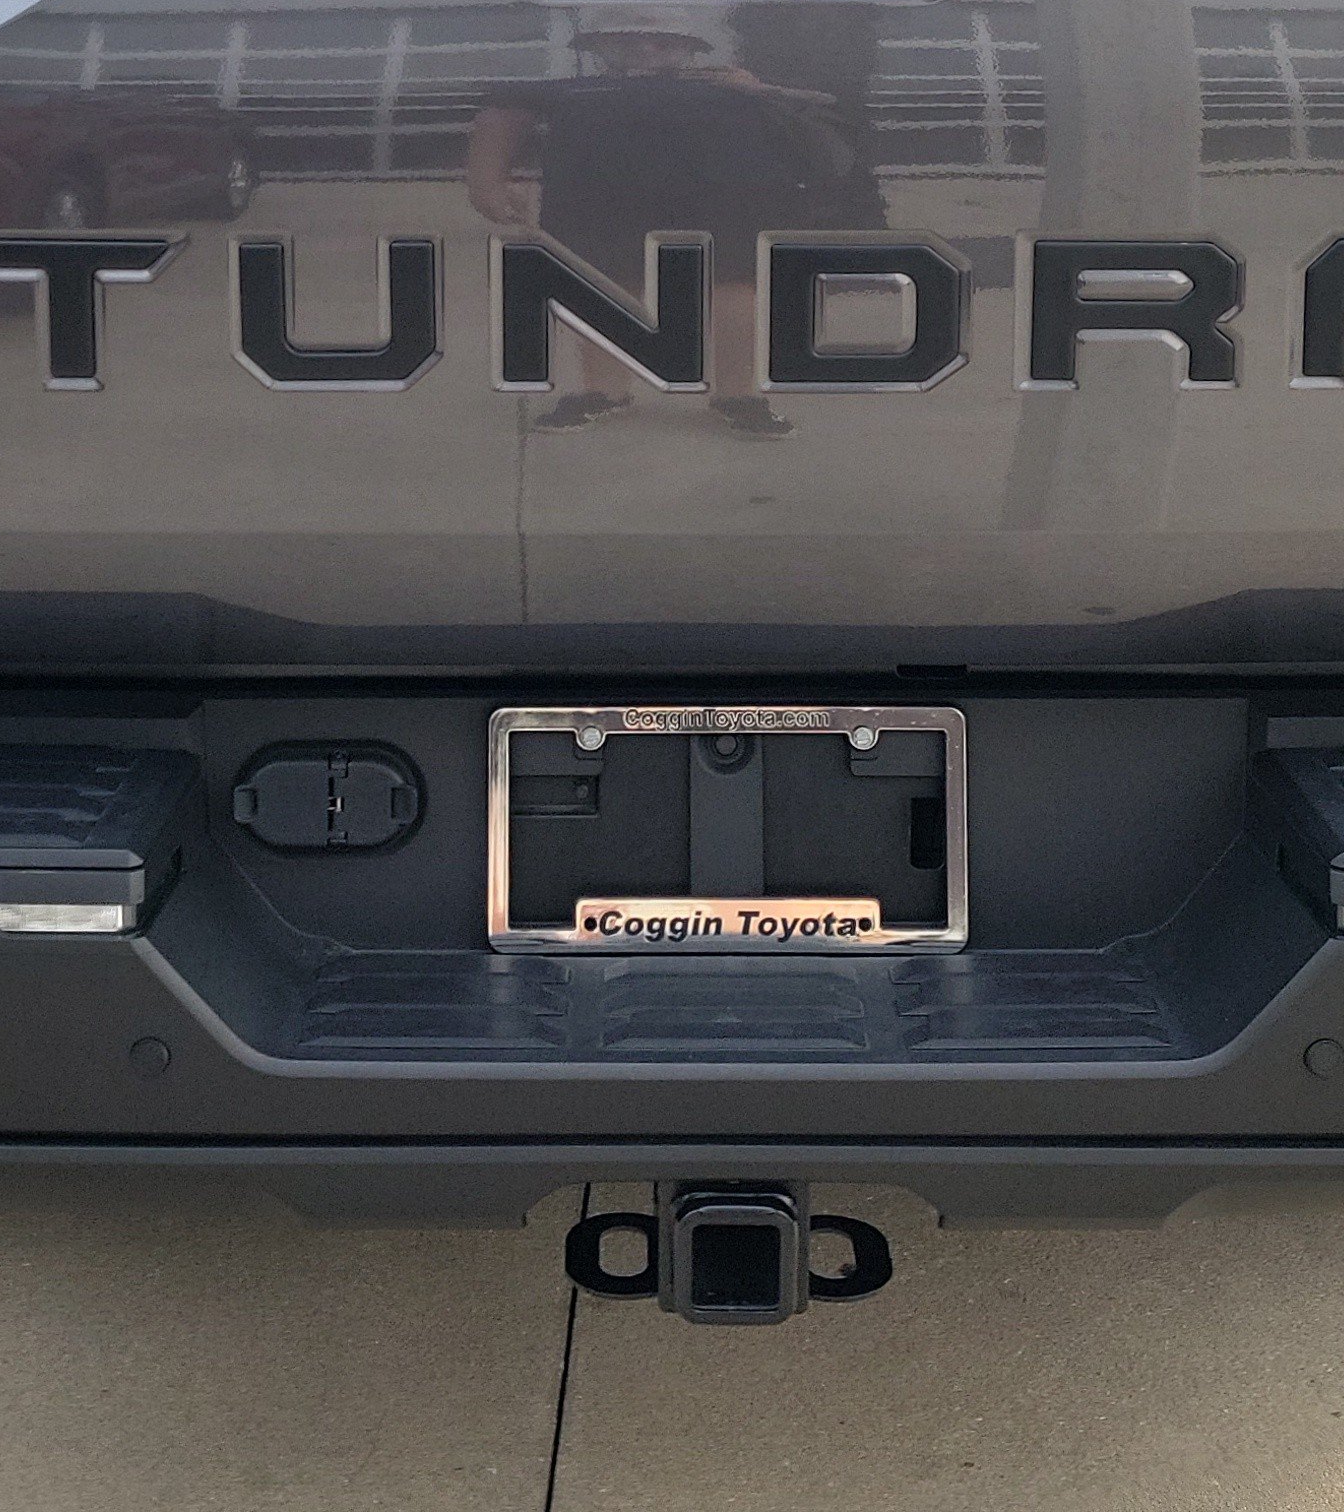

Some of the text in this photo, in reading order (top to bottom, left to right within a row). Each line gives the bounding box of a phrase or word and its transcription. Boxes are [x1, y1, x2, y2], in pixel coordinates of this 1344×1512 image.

[623, 708, 831, 731] CogginToyota.com
[598, 910, 859, 942] Coggin Toyota
